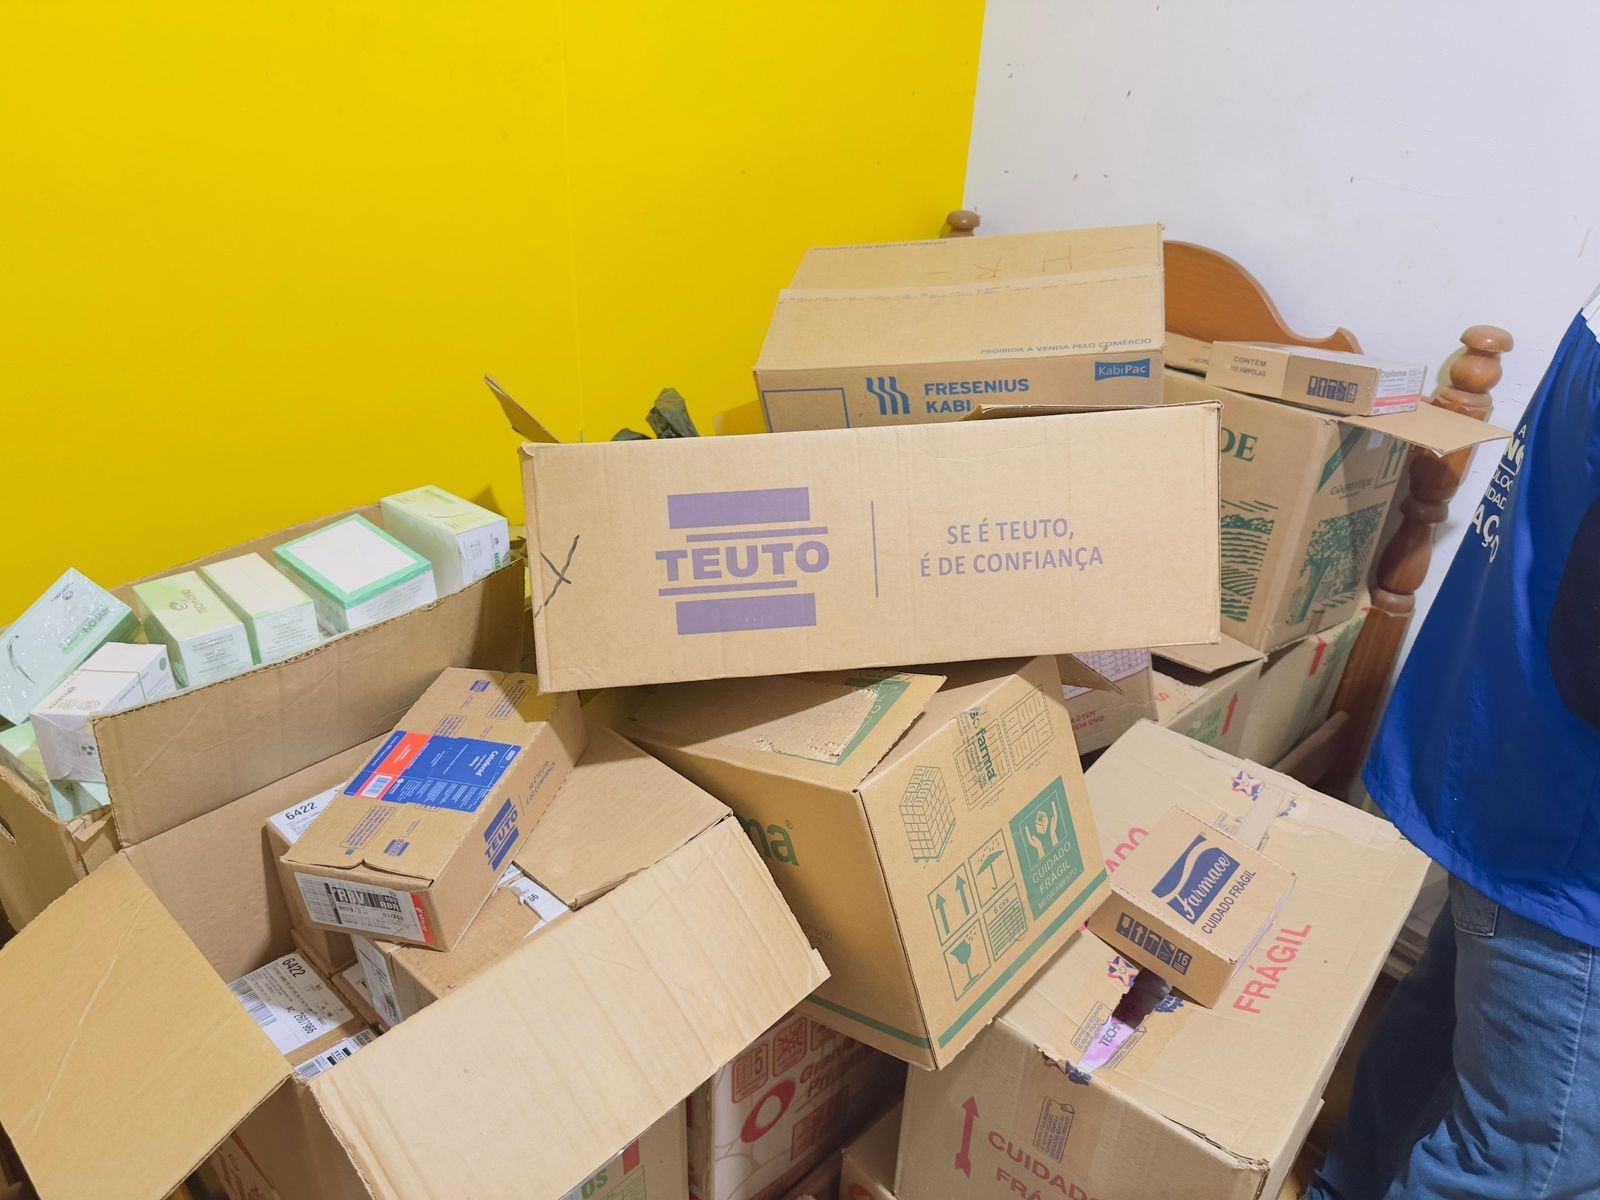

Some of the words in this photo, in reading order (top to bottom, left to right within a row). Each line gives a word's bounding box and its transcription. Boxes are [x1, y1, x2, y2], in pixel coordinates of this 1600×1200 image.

[1037, 344, 1069, 352] VENDA
[1072, 342, 1095, 350] PELO
[1098, 363, 1147, 376] KabiPac
[924, 379, 1029, 396] FRESENIUS
[926, 400, 971, 413] KABI
[946, 521, 972, 541] SE
[979, 516, 991, 540] É
[997, 516, 1075, 540] TEUTO,
[655, 539, 830, 582] TEUTO
[919, 554, 932, 578] É
[938, 554, 967, 577] DE
[973, 545, 1104, 576] CONFIANÇA
[285, 800, 317, 822] 6422
[485, 810, 518, 858] TEUTO
[1031, 840, 1072, 885] CUIDADO
[1038, 861, 1072, 895] FRÁGIL
[1202, 895, 1235, 935] CUIDADO
[1229, 869, 1257, 901] FRÁGIL
[282, 957, 306, 978] 6422
[1177, 951, 1190, 966] 16
[1232, 924, 1312, 1014] FRÁGIL
[988, 1131, 1099, 1200] CUIDAD
